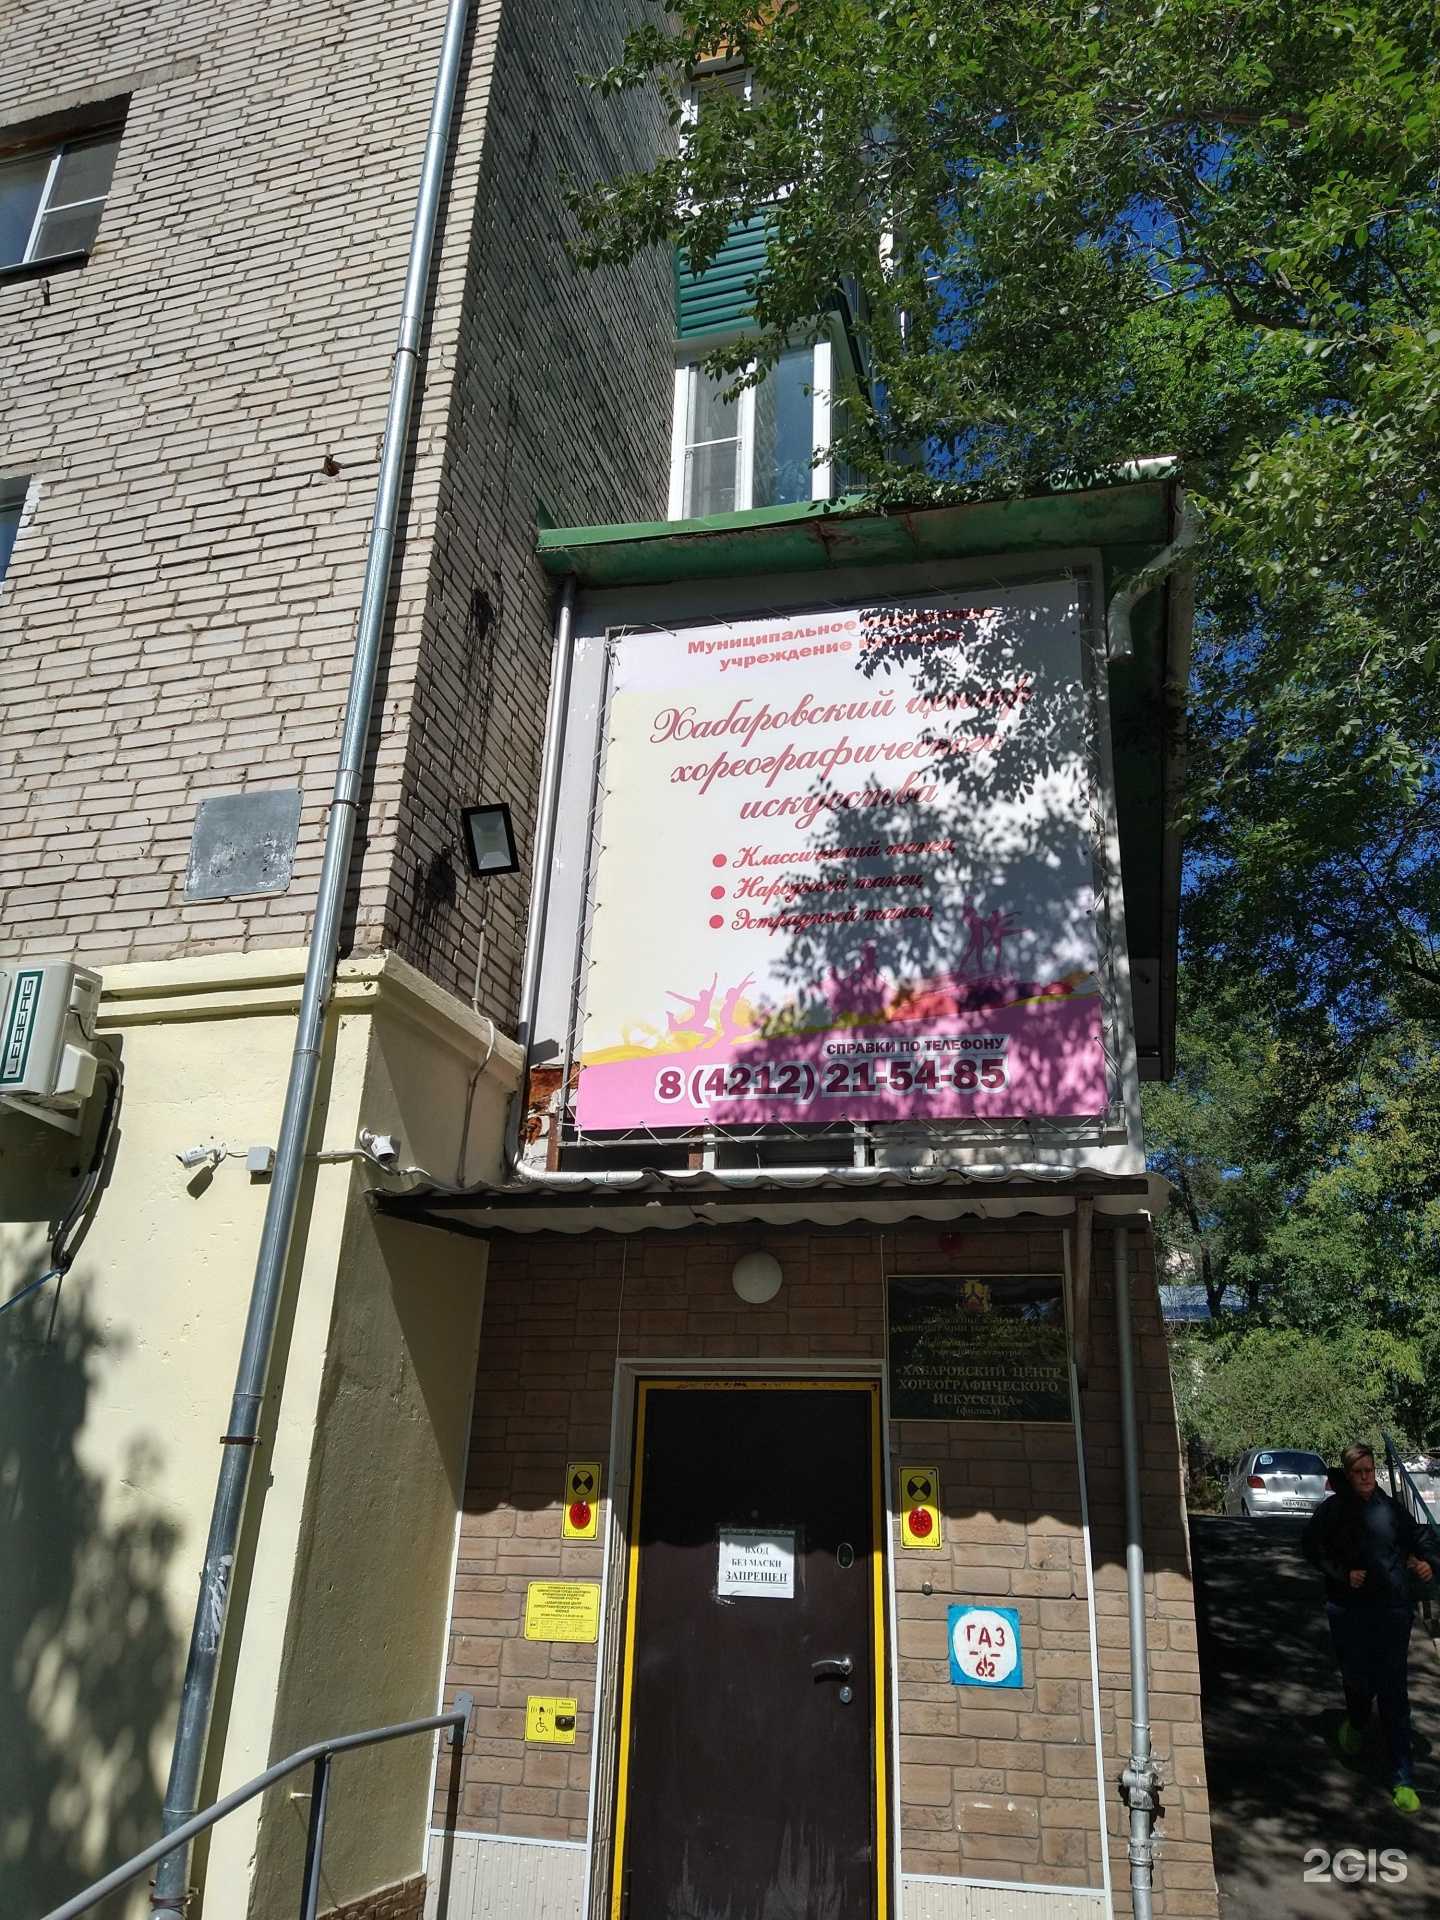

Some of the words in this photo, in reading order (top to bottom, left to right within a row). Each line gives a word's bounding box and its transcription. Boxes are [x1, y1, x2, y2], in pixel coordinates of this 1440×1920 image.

[687, 618, 858, 654] Муниципальное
[719, 640, 853, 672] учреждение
[649, 688, 897, 748] Хабаровский
[904, 672, 1033, 721] центр
[670, 732, 1004, 795] хореографического
[739, 770, 938, 830] искусства
[732, 839, 881, 869] Классический
[885, 839, 956, 855] танец
[732, 873, 849, 905] Народный
[854, 873, 924, 889] танец
[731, 905, 860, 936] Эстрадный
[863, 904, 934, 921] танец
[826, 1041, 896, 1055] СПРАВКИ
[900, 1040, 921, 1053] ПО
[924, 1037, 1005, 1052] ТЕЛЕФОНУ
[658, 1069, 682, 1100] 8
[691, 1064, 816, 1105] (4212)
[826, 1058, 1006, 1094] 21-54-85
[899, 1379, 1060, 1392] ХОРЕОГРАФИЧЕСКОГО
[731, 1558, 748, 1567] БЕЗ
[749, 1559, 783, 1569] МАСКИ
[744, 1545, 769, 1556] ВХОД
[726, 1571, 788, 1582] ЗАПРЕЩЕН
[965, 1623, 1006, 1649] ГАЗ
